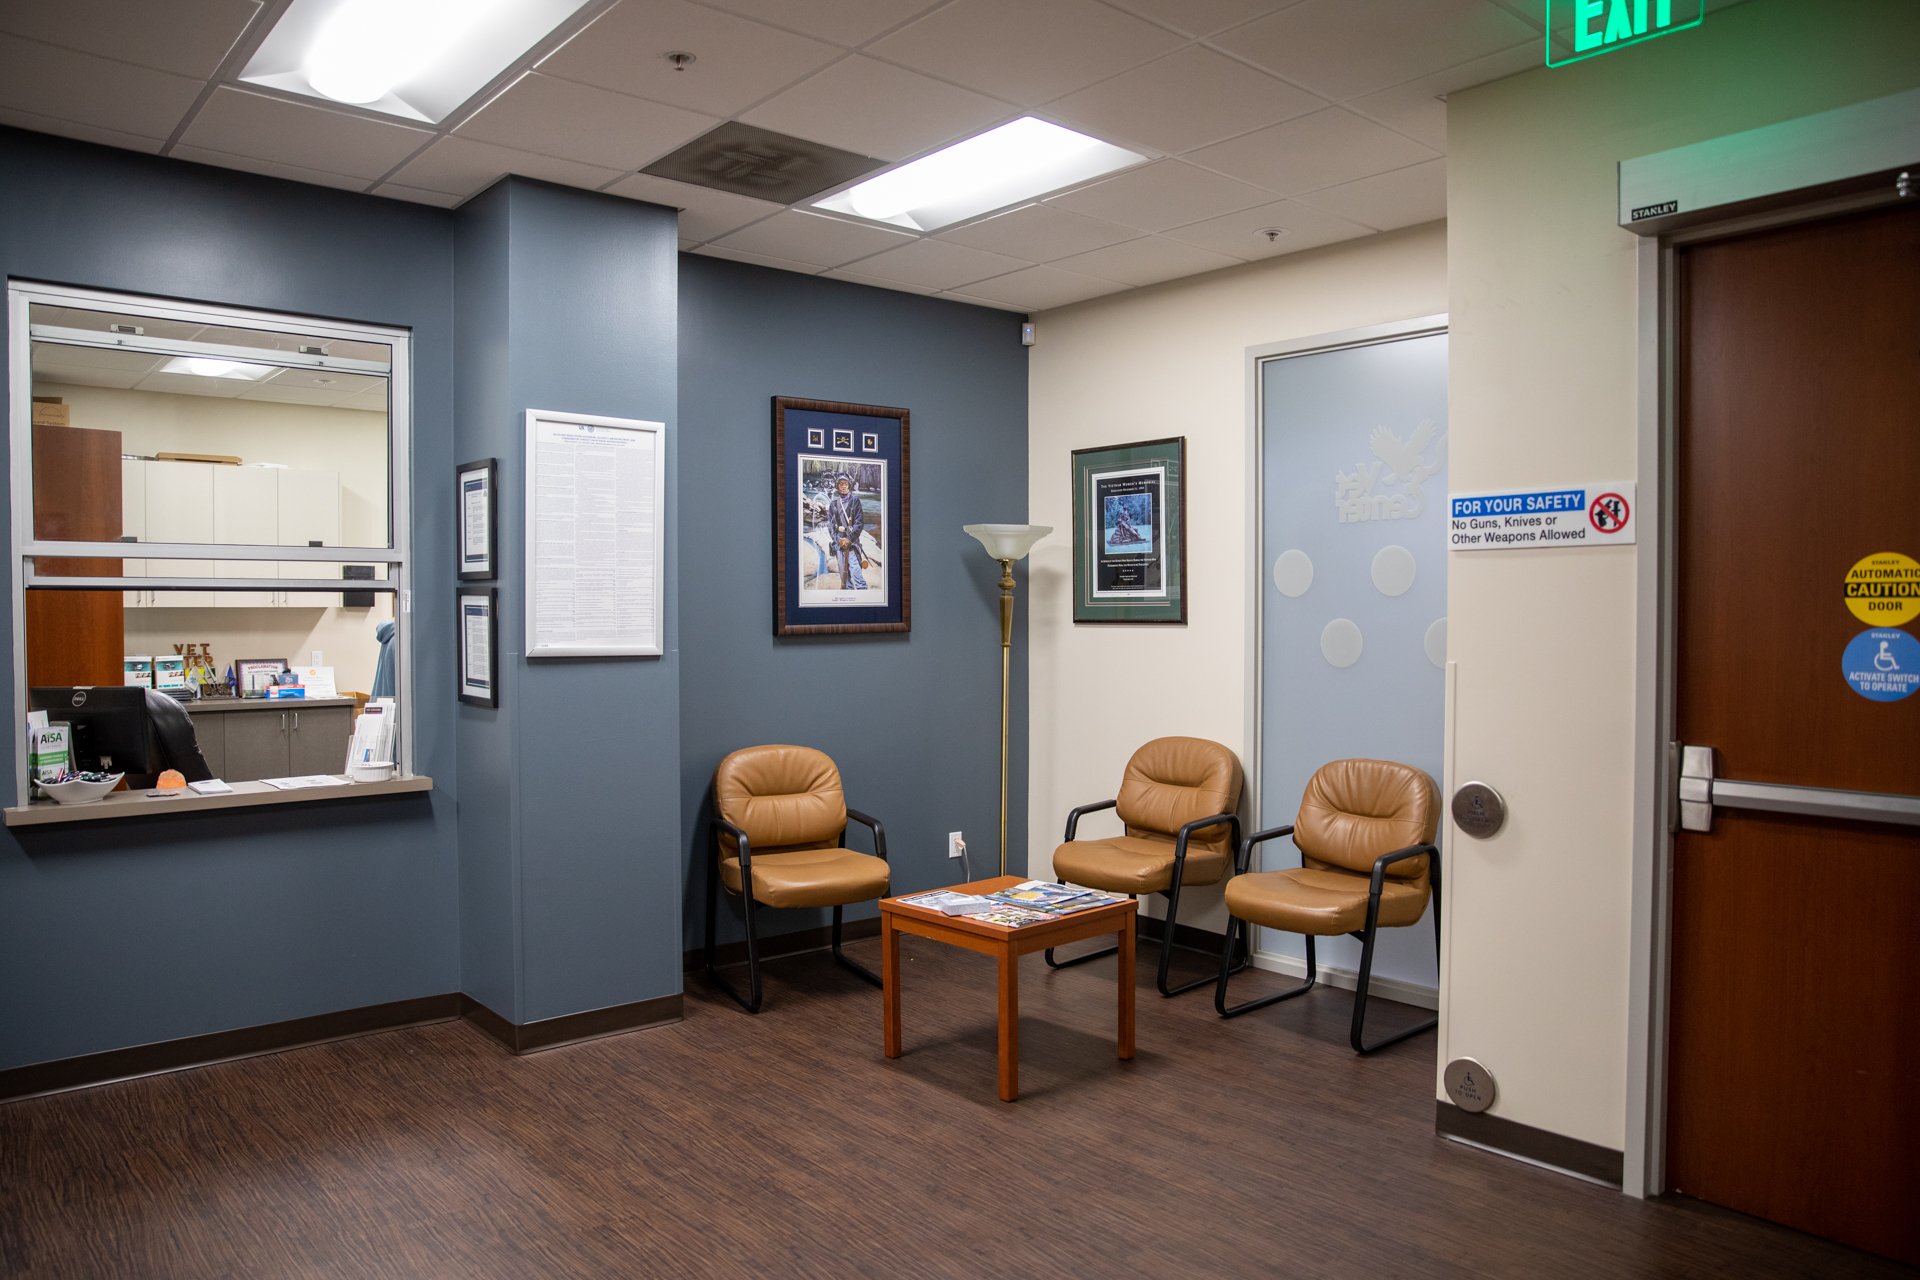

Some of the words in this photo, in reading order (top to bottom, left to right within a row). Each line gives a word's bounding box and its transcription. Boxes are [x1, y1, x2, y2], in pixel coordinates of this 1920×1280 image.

[1632, 202, 1676, 219] STANLEY
[1455, 502, 1481, 515] FOR
[1484, 498, 1522, 513] YOUR
[1526, 494, 1581, 510] SAFETY
[1452, 520, 1467, 530] No
[1469, 518, 1501, 529] Guns,
[1504, 516, 1542, 527] Knives
[1545, 516, 1558, 526] or
[1452, 533, 1481, 544] Other
[1484, 531, 1536, 544] Weapons
[1539, 528, 1586, 540] Allowed
[1851, 569, 1920, 579] AUTOMATIC
[1846, 583, 1920, 597] CAUTION
[1868, 601, 1902, 611] DOOR
[173, 643, 210, 655] VET
[183, 655, 214, 668] TER
[1849, 672, 1885, 682] ACTIVATE
[1887, 674, 1919, 683] SWITCH
[1860, 682, 1870, 691] TO
[1871, 682, 1907, 693] OPERATE
